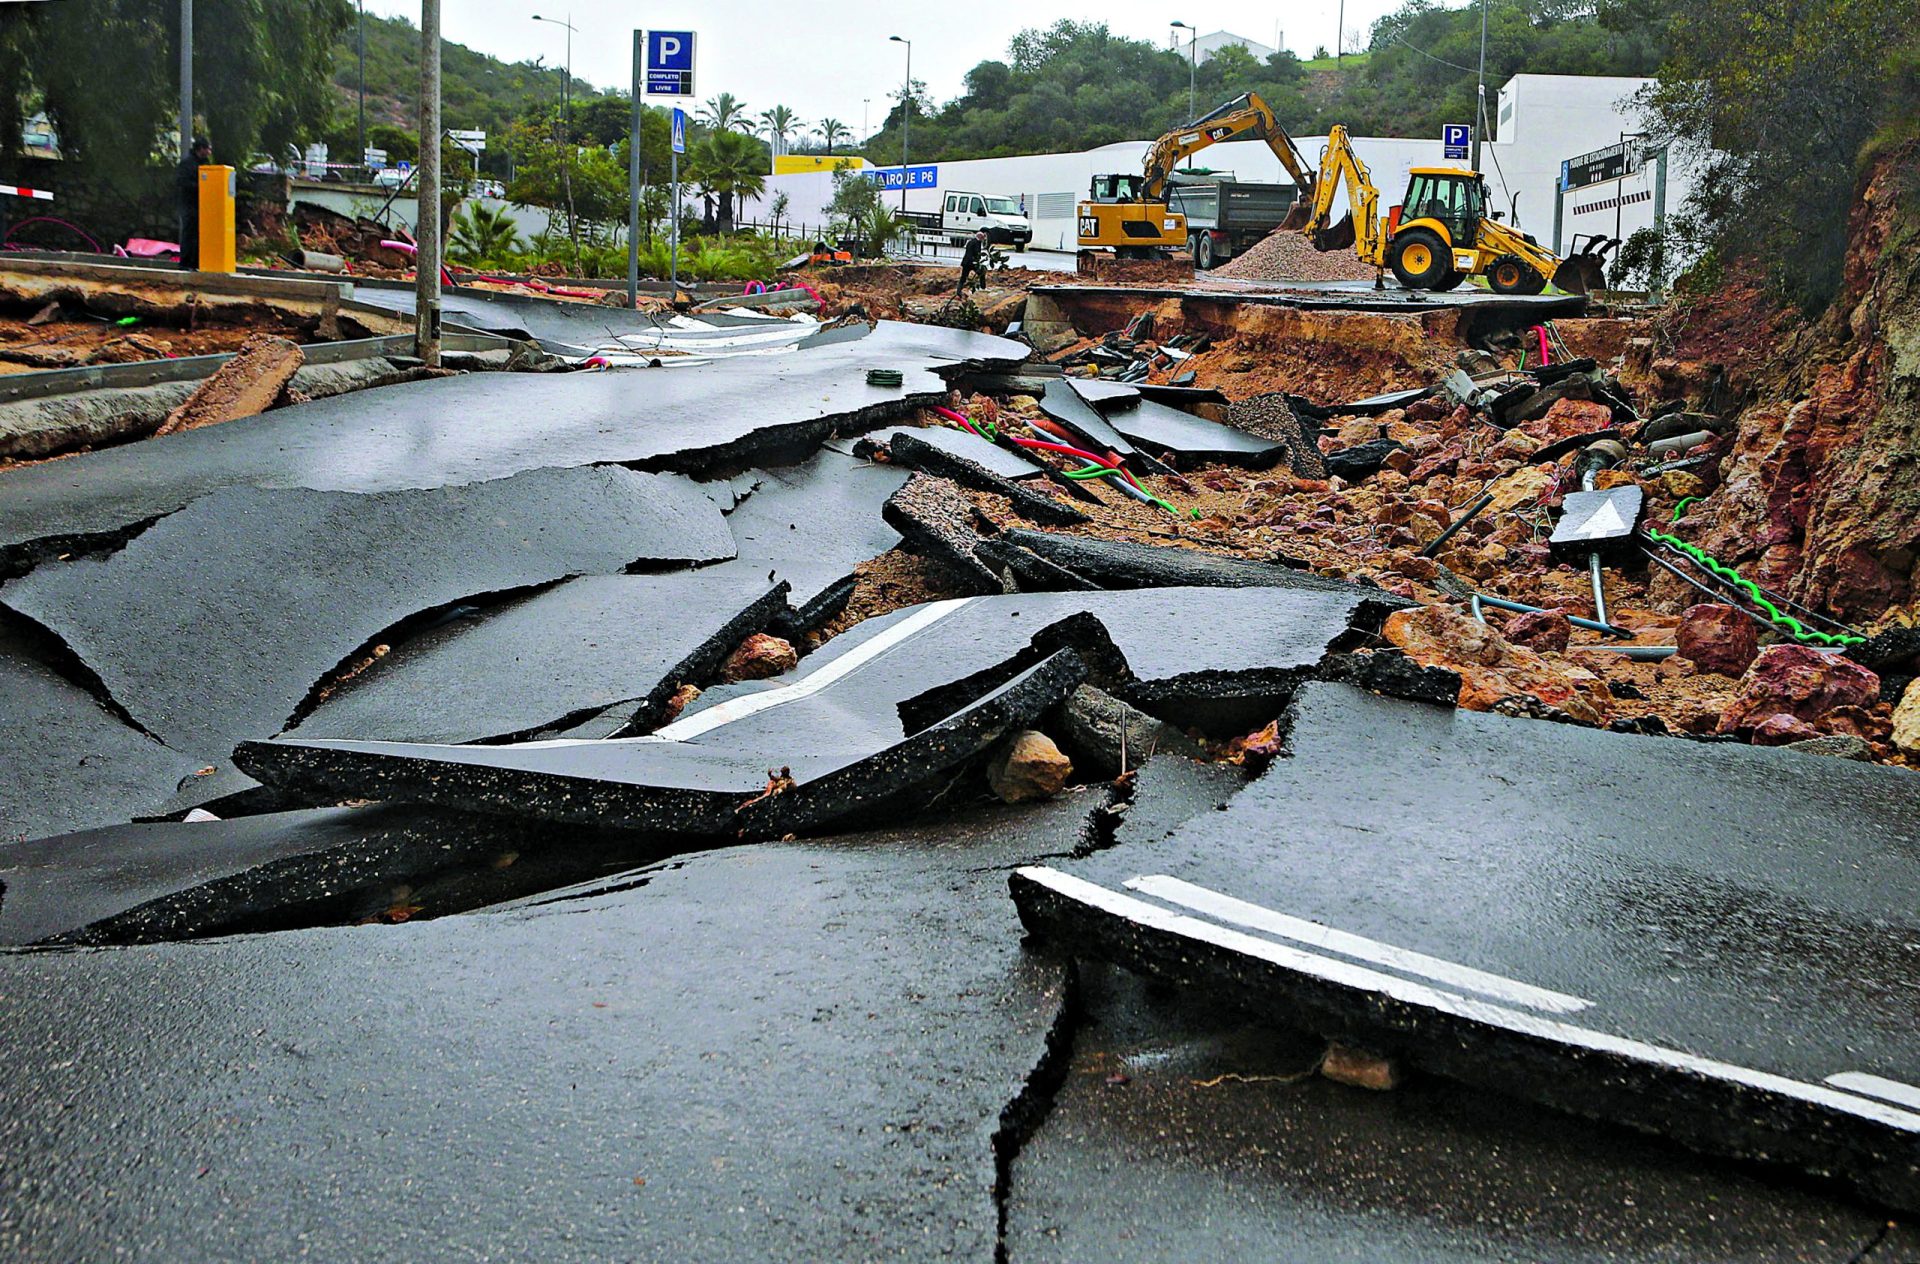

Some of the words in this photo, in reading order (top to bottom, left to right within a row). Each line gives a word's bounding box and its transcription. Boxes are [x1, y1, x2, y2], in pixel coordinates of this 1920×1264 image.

[660, 36, 681, 65] P
[1212, 128, 1224, 140] CAT
[1451, 128, 1463, 144] P
[921, 171, 934, 183] P6
[1080, 218, 1097, 236] CAT
